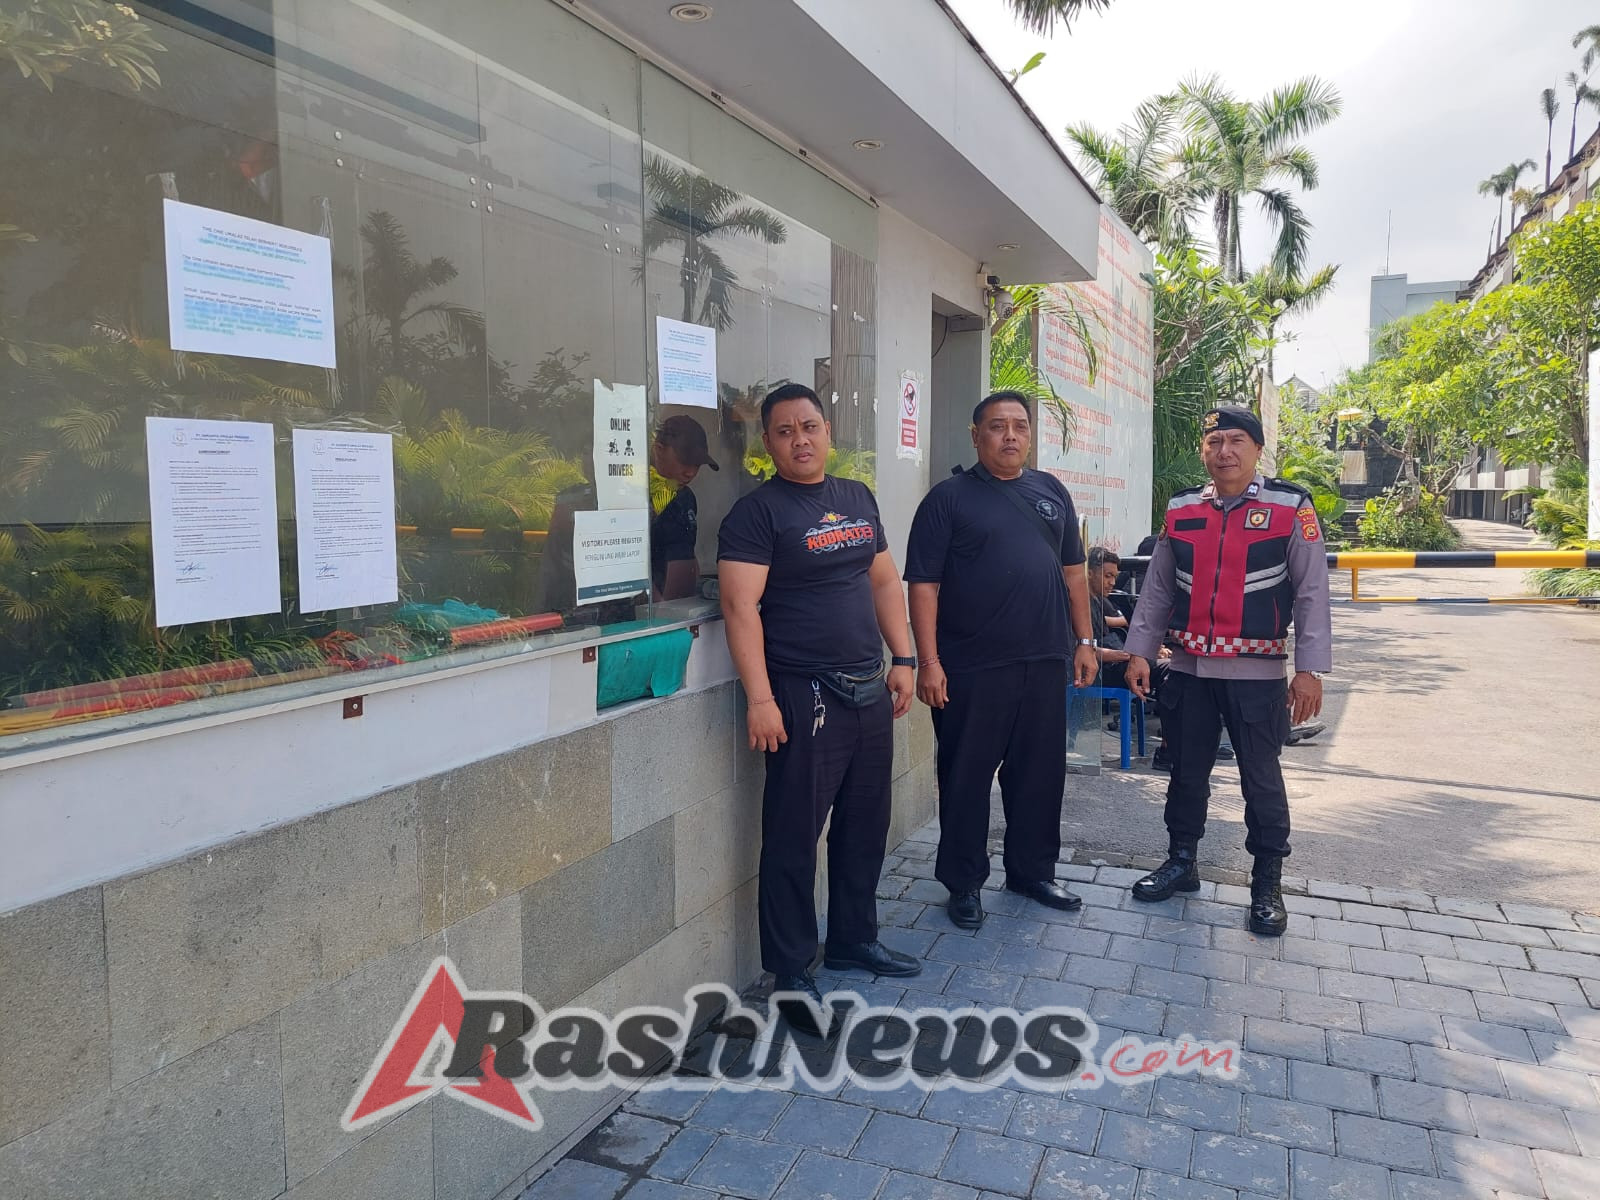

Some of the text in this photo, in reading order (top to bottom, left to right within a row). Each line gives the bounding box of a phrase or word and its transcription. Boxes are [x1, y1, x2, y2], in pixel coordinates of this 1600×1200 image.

[610, 417, 631, 431] ONLINE
[608, 463, 634, 477] DRIVERS
[581, 537, 643, 548] VISITORS PLEASE REGISTER
